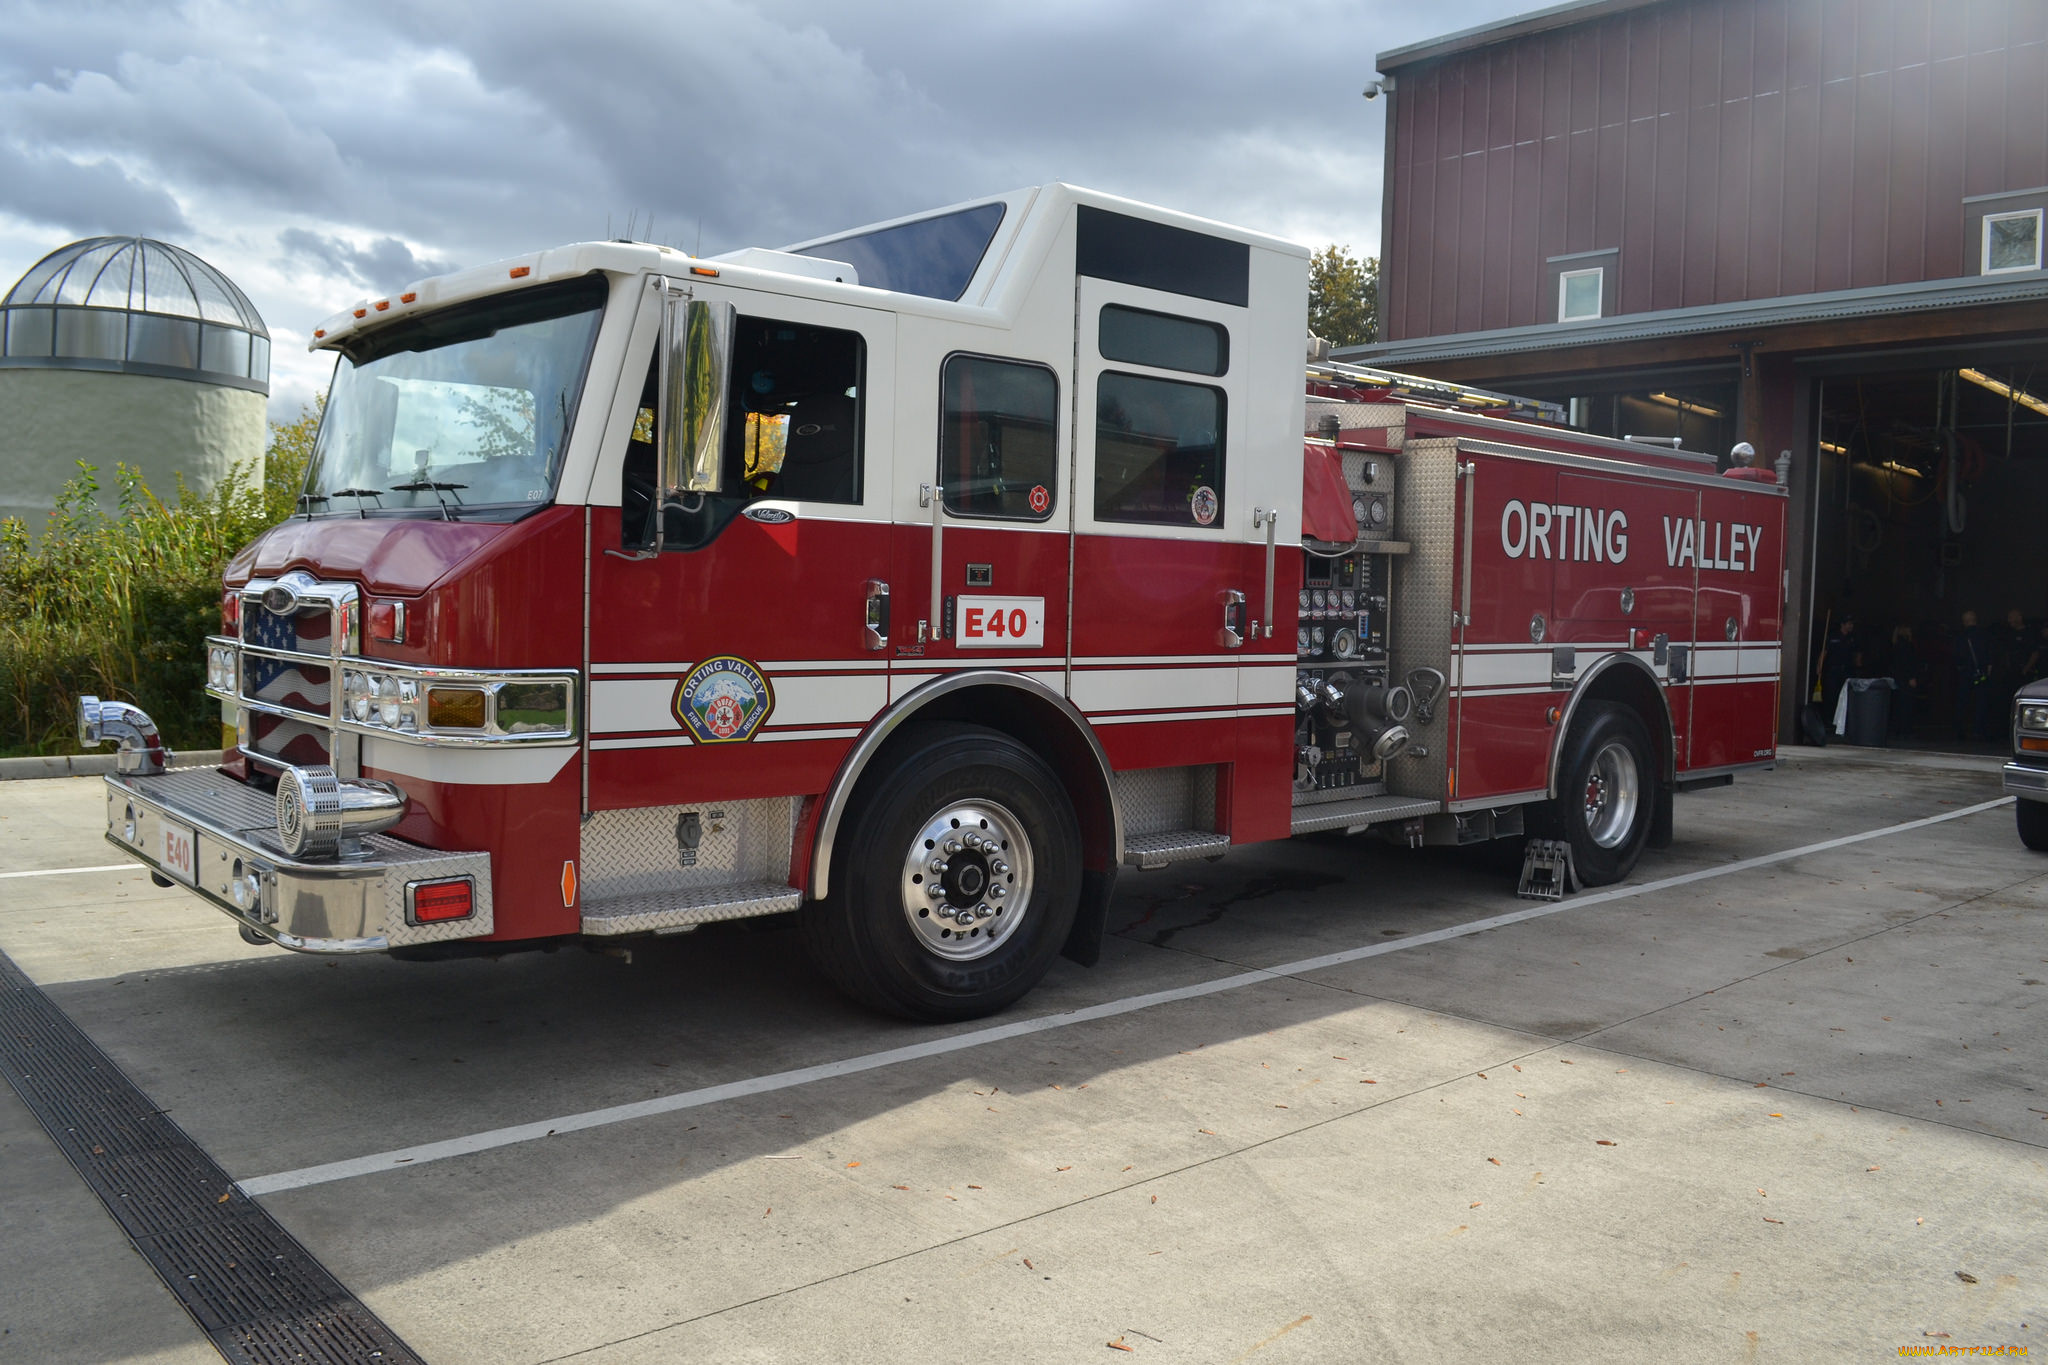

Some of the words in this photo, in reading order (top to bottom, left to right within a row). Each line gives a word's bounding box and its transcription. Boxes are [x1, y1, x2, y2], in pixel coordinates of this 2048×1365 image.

[757, 509, 785, 521] Velocity
[1501, 499, 1628, 565] ORTING
[1663, 515, 1762, 572] VALLEY
[965, 608, 1027, 638] E40
[684, 661, 723, 698] ORTING
[727, 661, 765, 695] VALLEY
[688, 712, 702, 729] FIRE
[743, 705, 764, 732] RESCUE
[167, 831, 190, 873] E40
